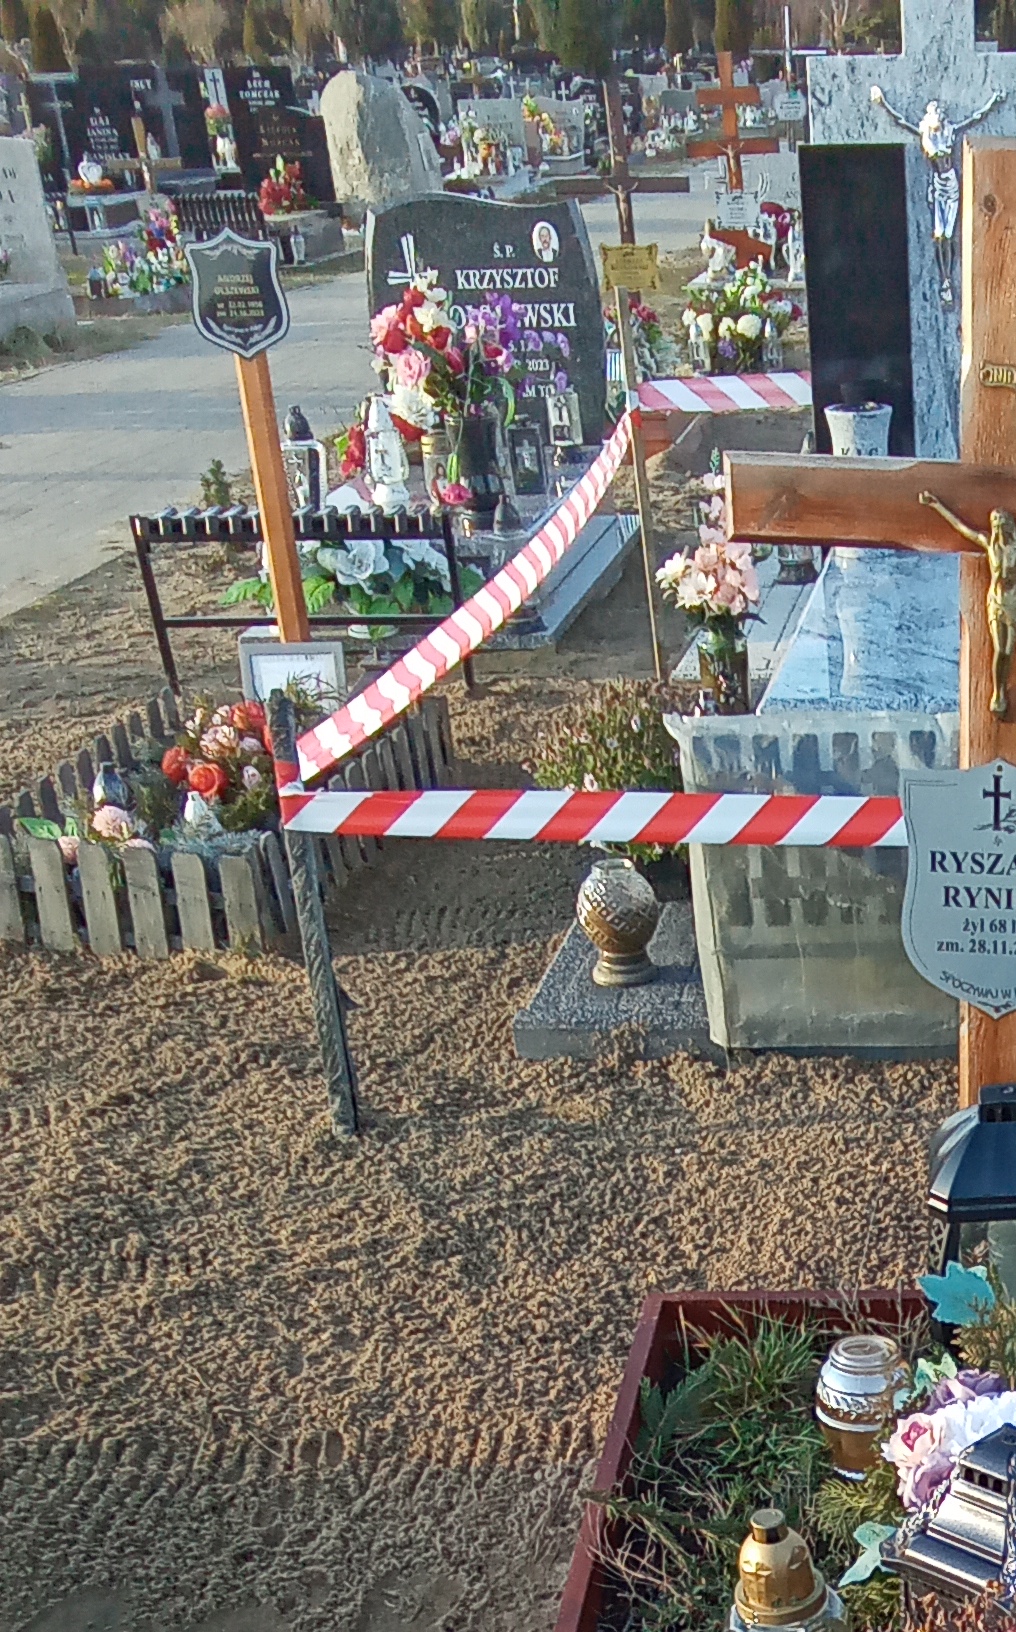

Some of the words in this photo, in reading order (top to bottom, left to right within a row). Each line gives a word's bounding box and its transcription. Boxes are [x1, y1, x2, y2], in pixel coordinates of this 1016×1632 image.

[454, 267, 559, 290] KRZYSZTOF
[989, 919, 1007, 934] 68
[936, 940, 964, 953] zm.
[939, 970, 999, 1000] SPOCZYWAJ
[1000, 988, 1012, 999] W
